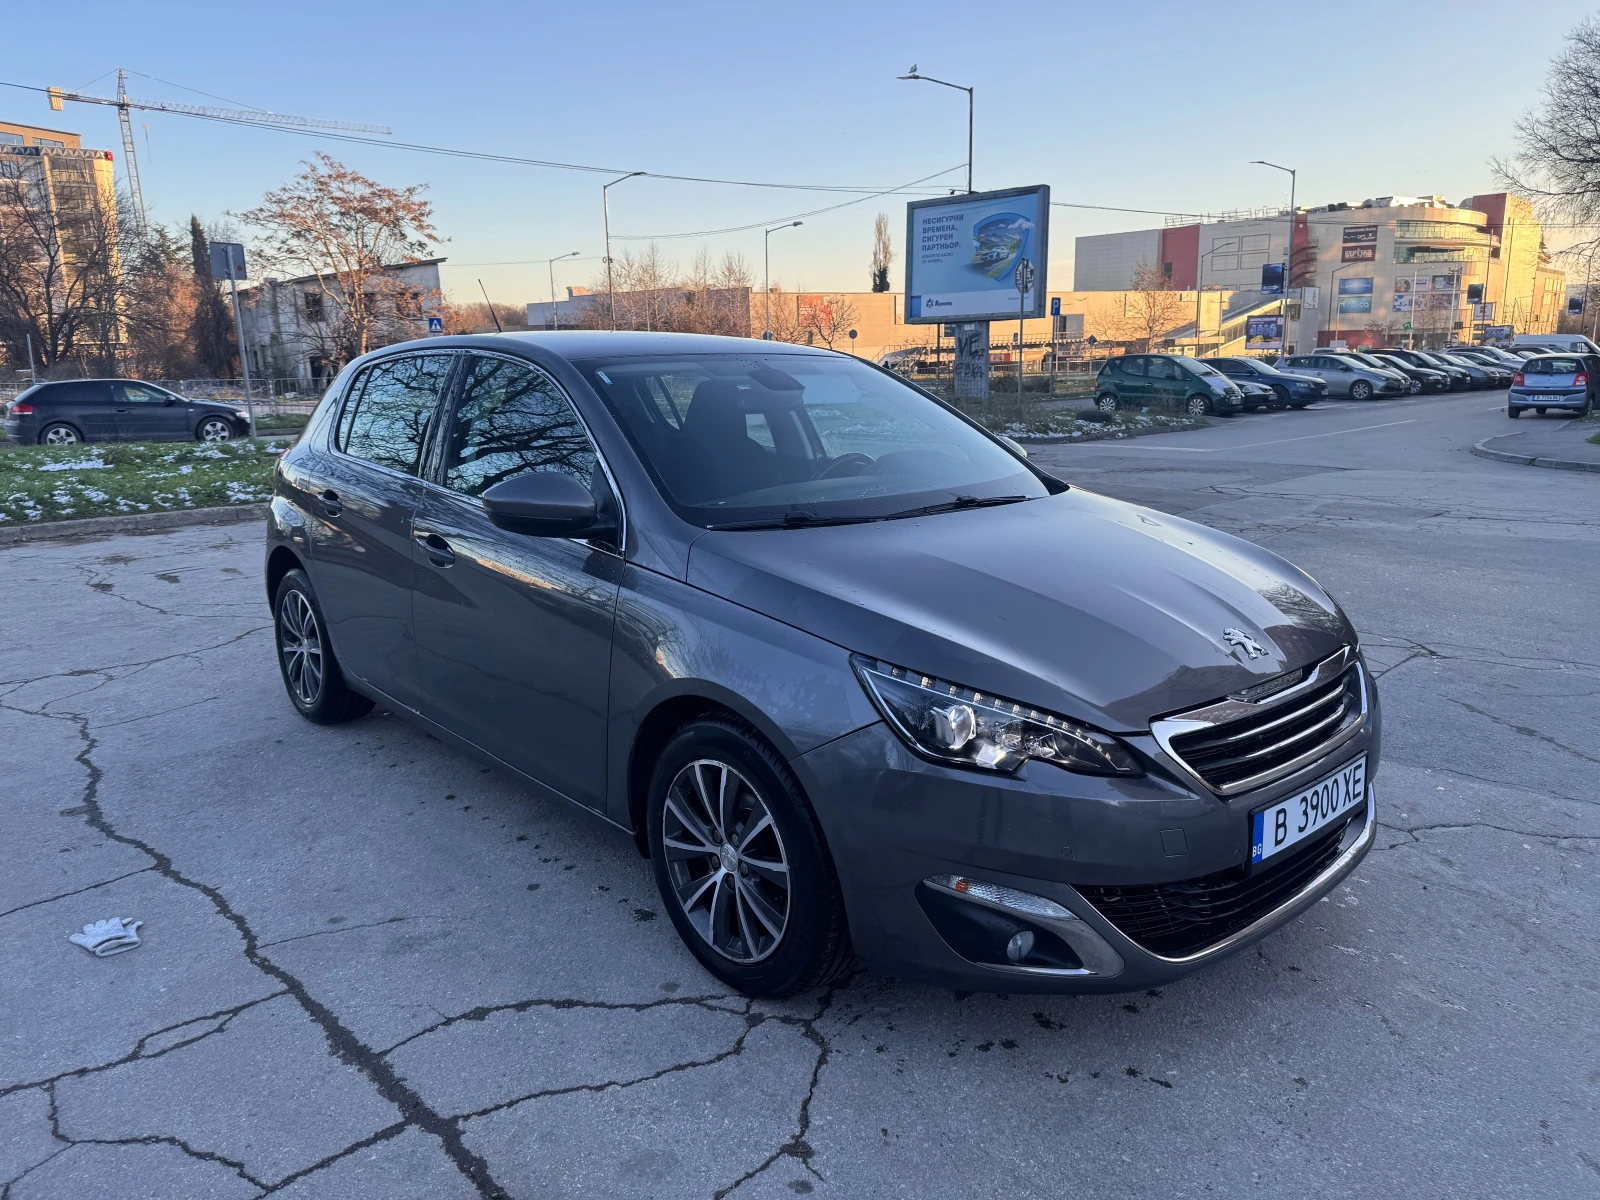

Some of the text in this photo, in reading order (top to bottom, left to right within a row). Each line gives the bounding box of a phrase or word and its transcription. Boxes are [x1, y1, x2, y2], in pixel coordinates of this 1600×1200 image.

[922, 214, 964, 225] НЕСИГУРНИ
[922, 225, 958, 234] ВРЕМЕНА,
[922, 234, 954, 243] СИГУРЕН
[922, 242, 961, 252] ПАРТНЬОР.
[1053, 299, 1059, 314] P
[1274, 762, 1363, 847] B 3900 XE
[1252, 843, 1262, 858] BG
